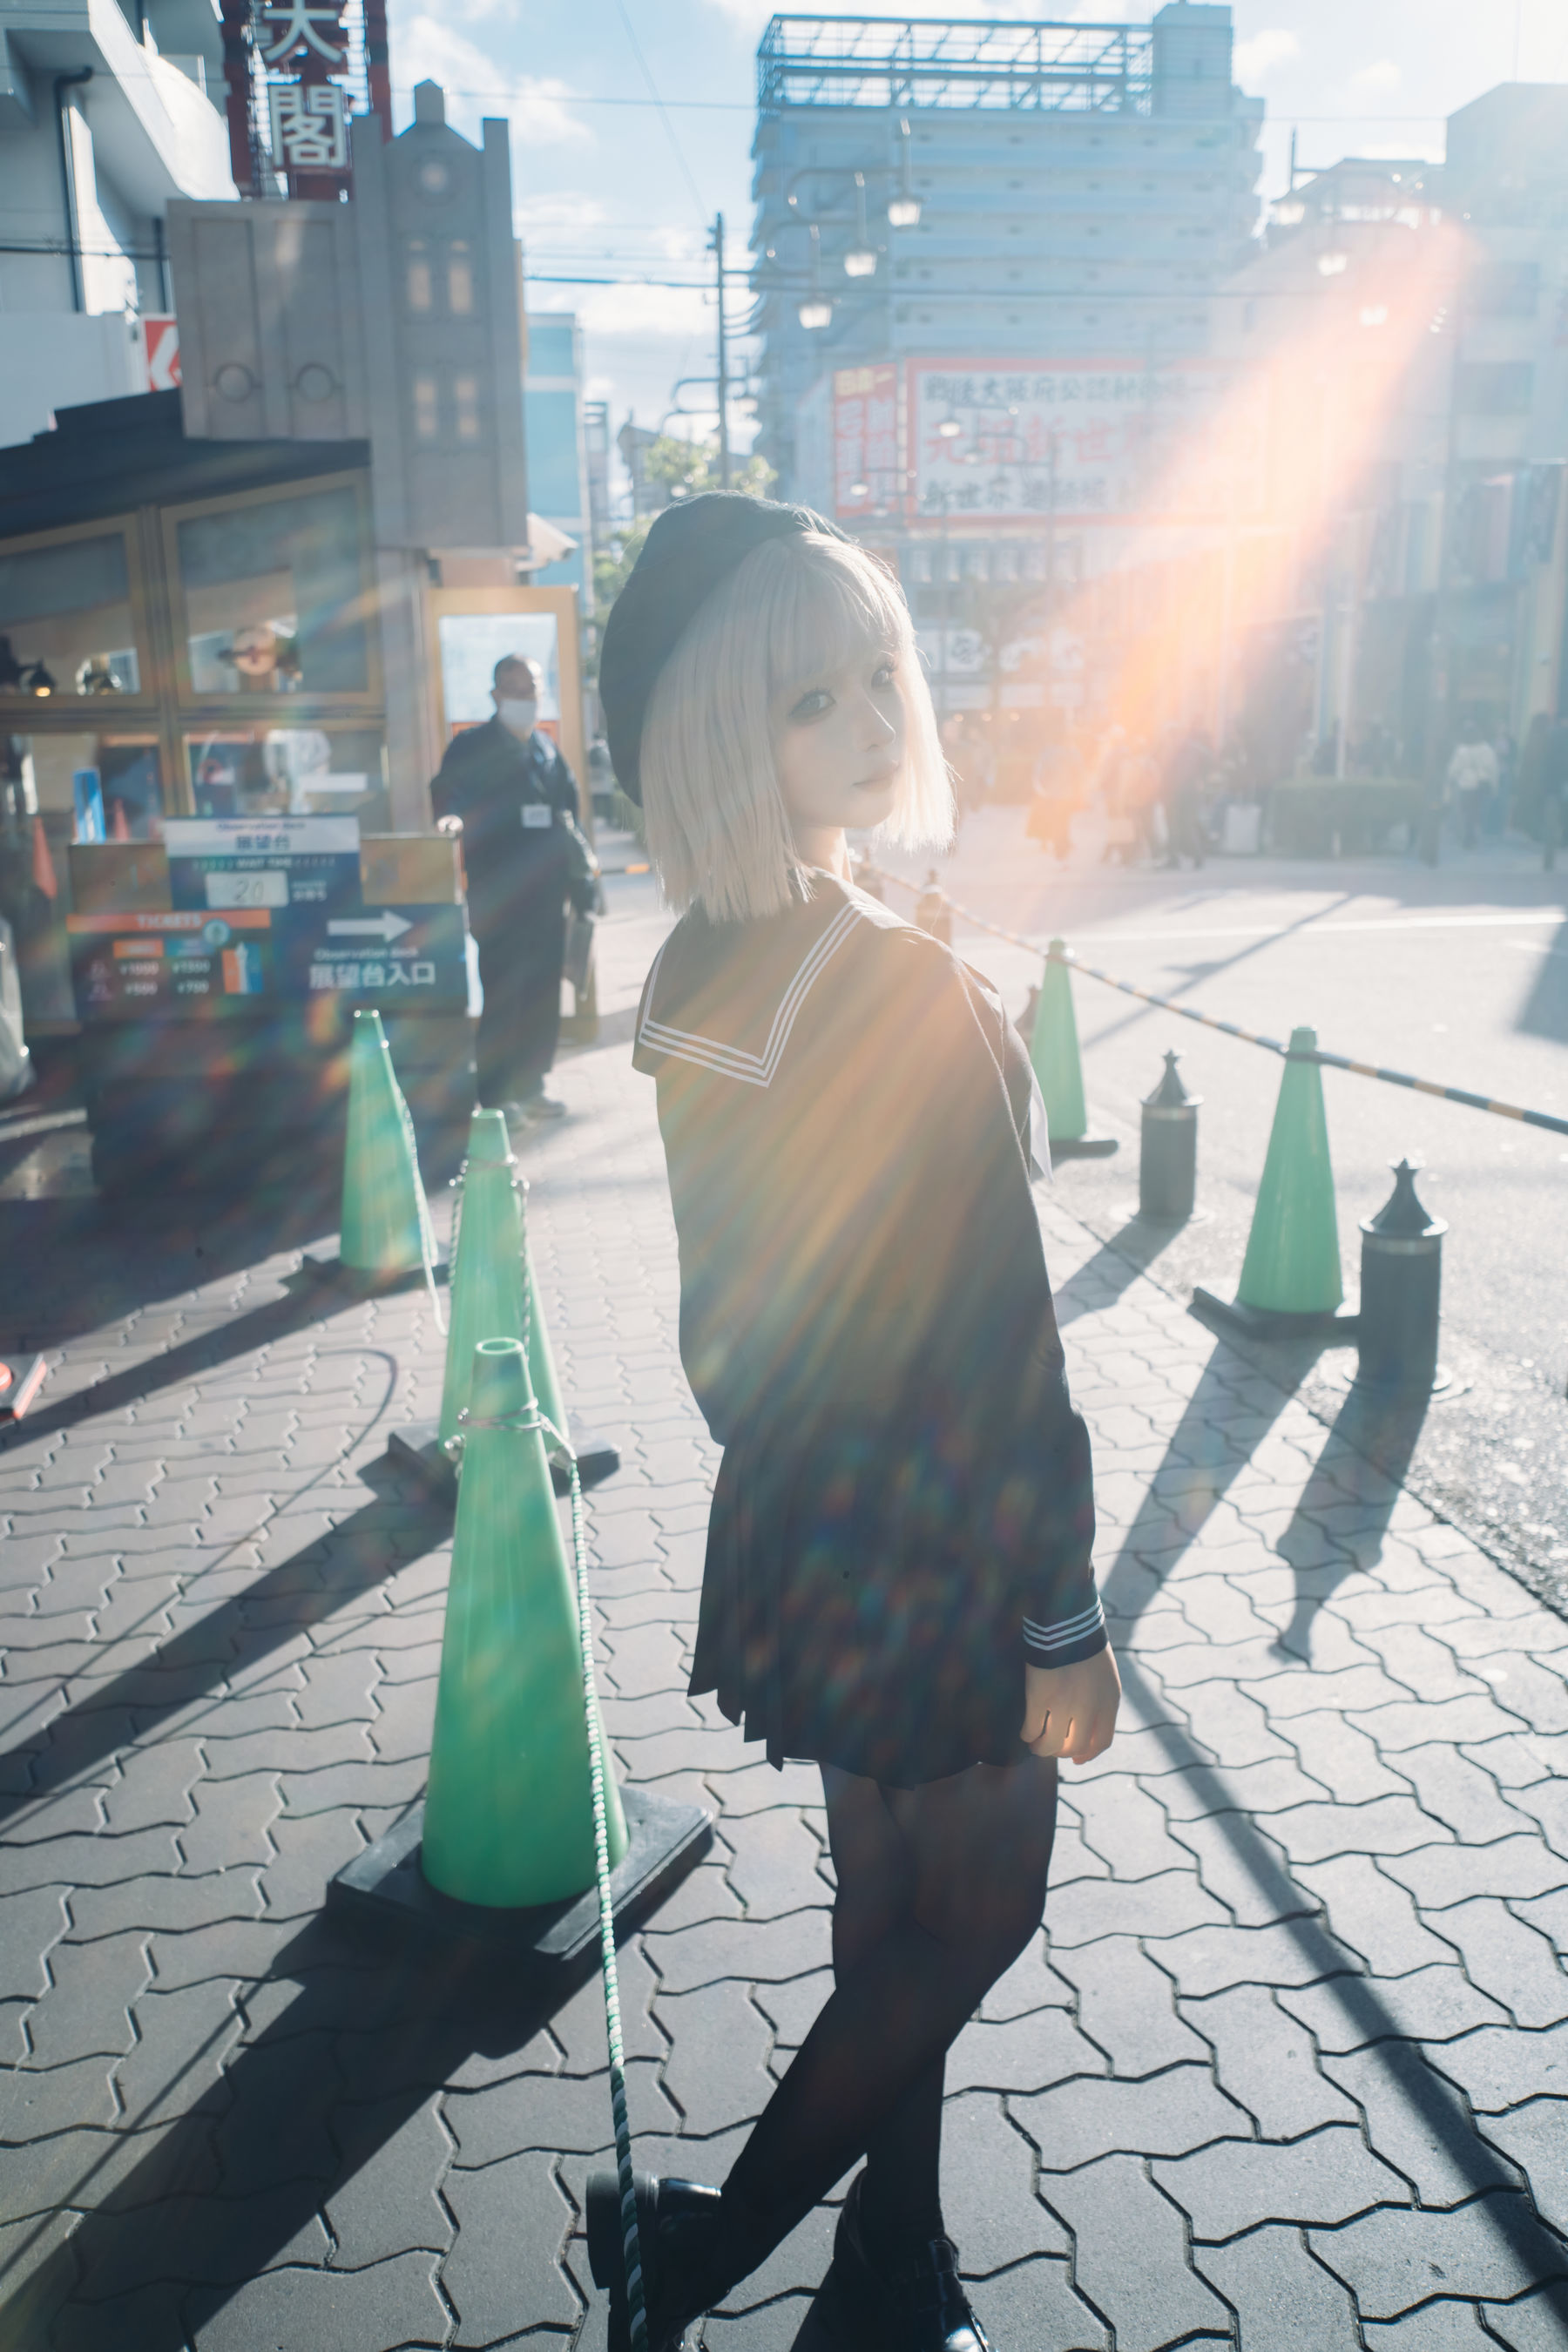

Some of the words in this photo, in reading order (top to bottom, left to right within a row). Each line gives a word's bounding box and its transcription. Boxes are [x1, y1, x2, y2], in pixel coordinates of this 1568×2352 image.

[233, 877, 265, 903] 20
[136, 914, 203, 929] TICKETS
[308, 961, 436, 990] 展望台入口
